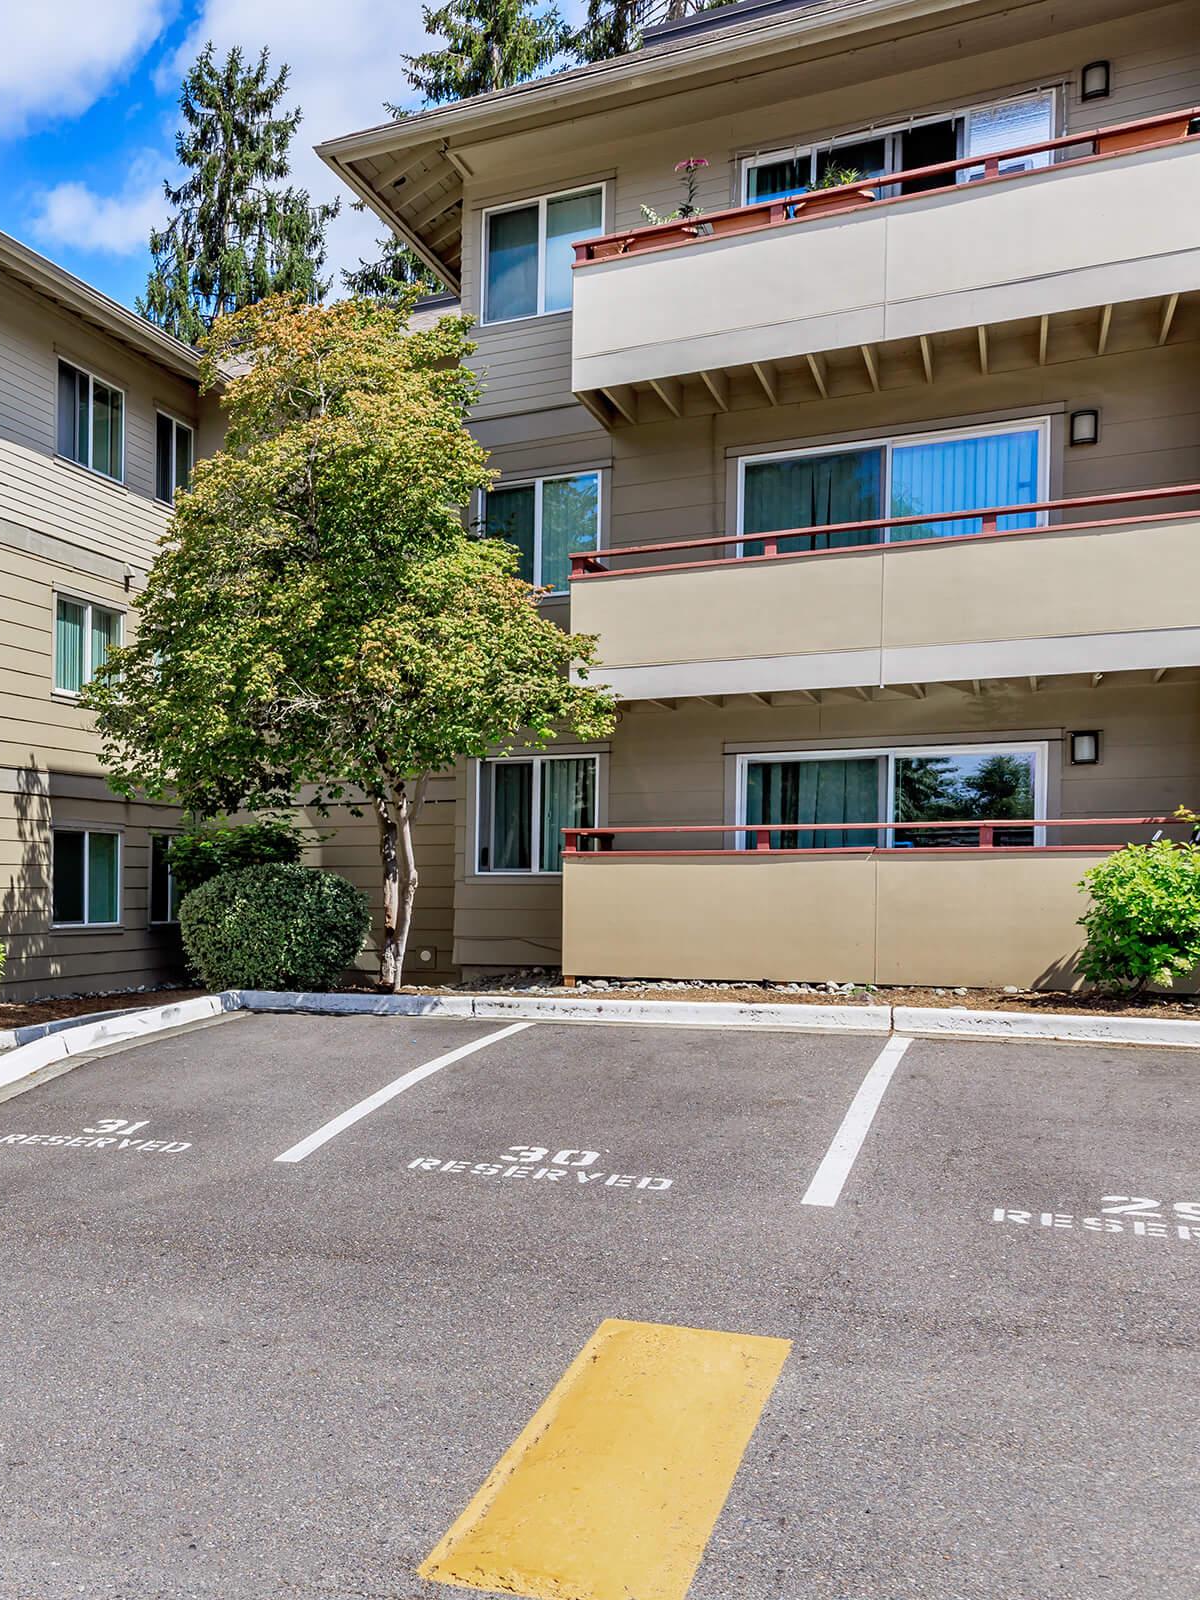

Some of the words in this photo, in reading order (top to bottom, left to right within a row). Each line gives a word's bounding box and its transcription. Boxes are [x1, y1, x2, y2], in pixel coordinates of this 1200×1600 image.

[83, 1119, 151, 1135] 31
[498, 1145, 602, 1167] 30
[407, 1157, 673, 1191] RESERVED
